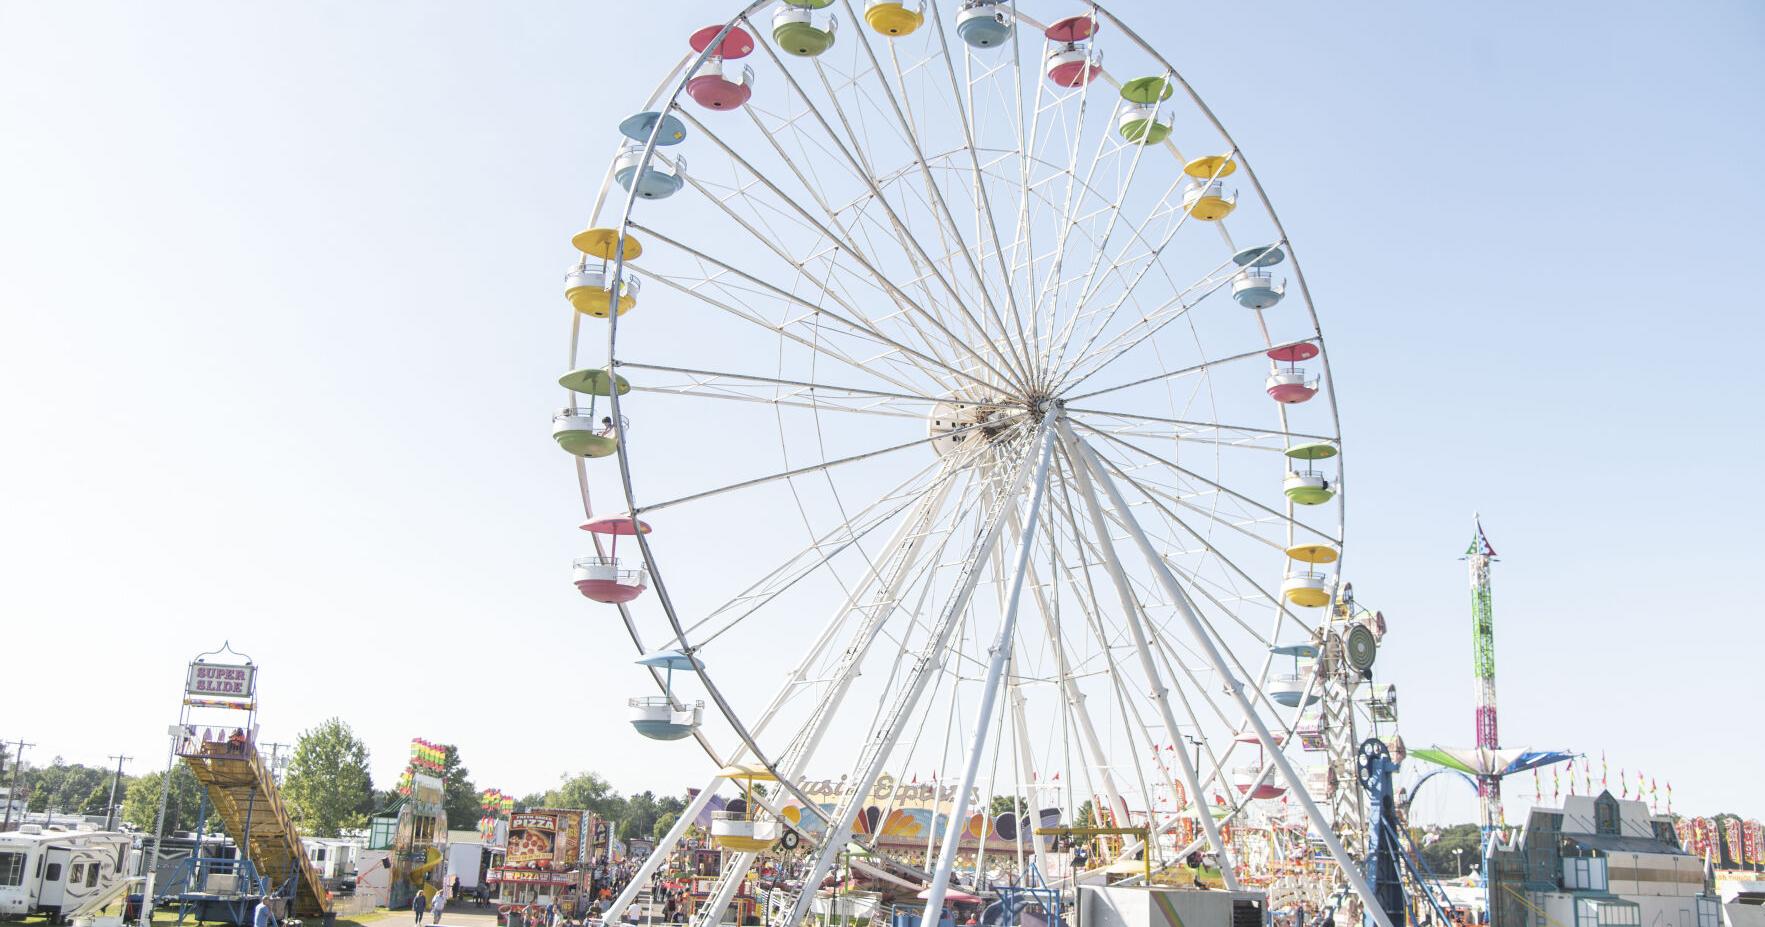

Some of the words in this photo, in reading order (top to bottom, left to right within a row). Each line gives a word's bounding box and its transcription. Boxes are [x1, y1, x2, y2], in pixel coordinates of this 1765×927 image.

[197, 667, 245, 680] SUPER
[197, 680, 242, 693] SLIDE
[512, 819, 555, 830] PIZZA
[514, 872, 540, 880] PIZZA
